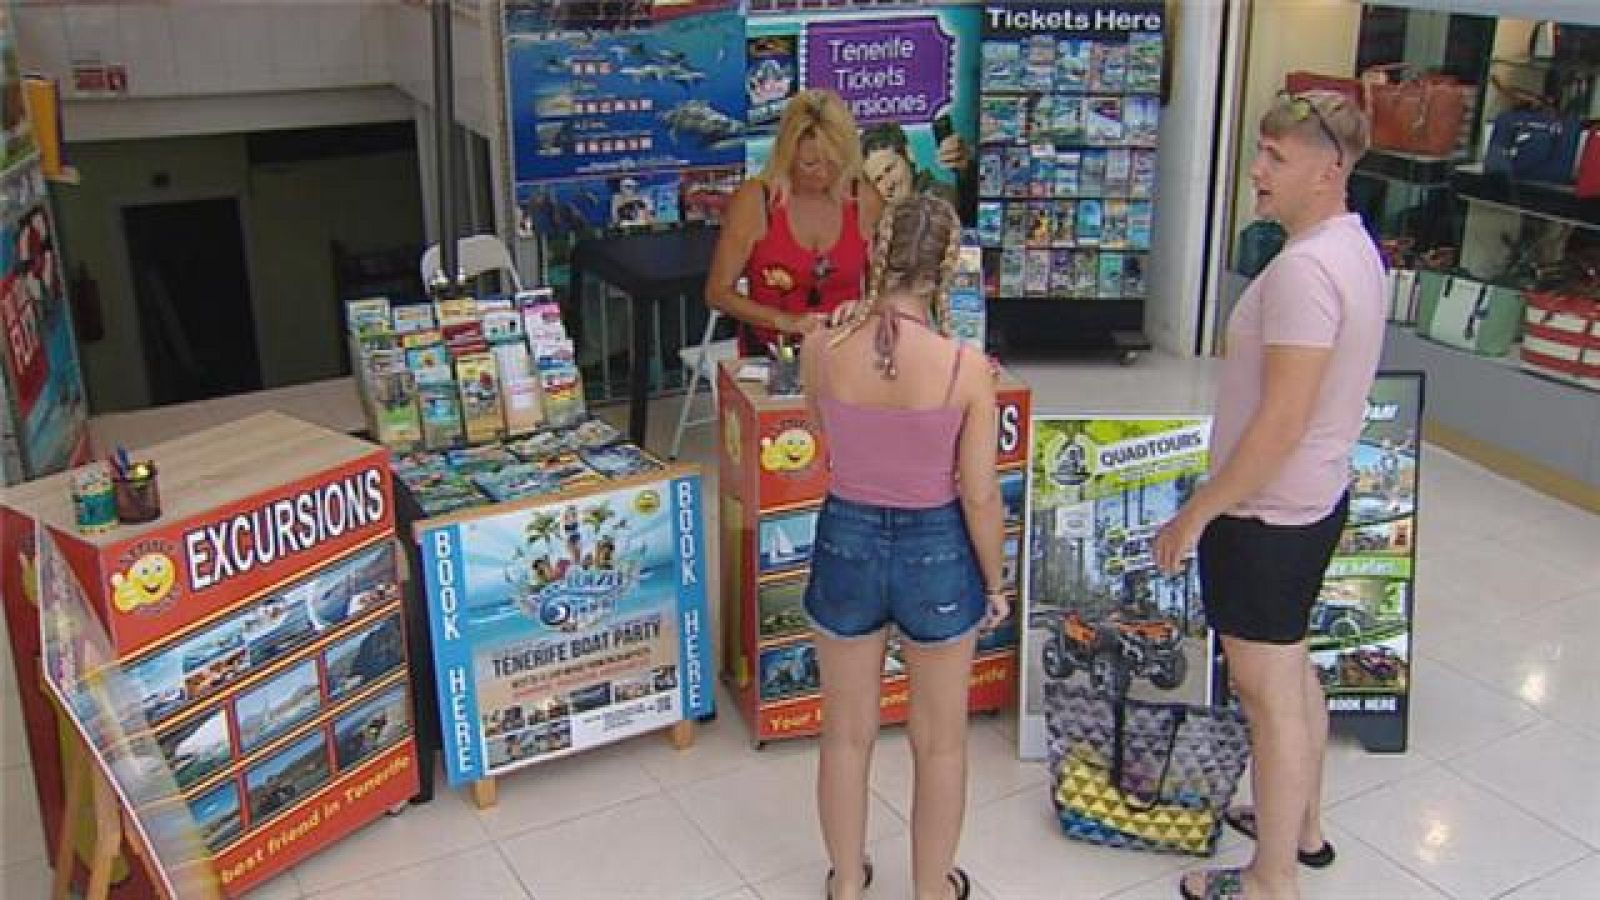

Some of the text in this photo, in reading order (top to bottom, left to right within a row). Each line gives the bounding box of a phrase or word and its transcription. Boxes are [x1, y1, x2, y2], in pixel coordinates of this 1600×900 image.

[984, 8, 1161, 31] Tickets Here
[827, 37, 915, 63] Tenerife
[833, 65, 906, 91] Tickets
[1100, 429, 1202, 467] QUADTOURS
[186, 468, 383, 591] EXCURSIONS
[493, 639, 568, 677] TENERIFE
[570, 627, 609, 659] BOAT
